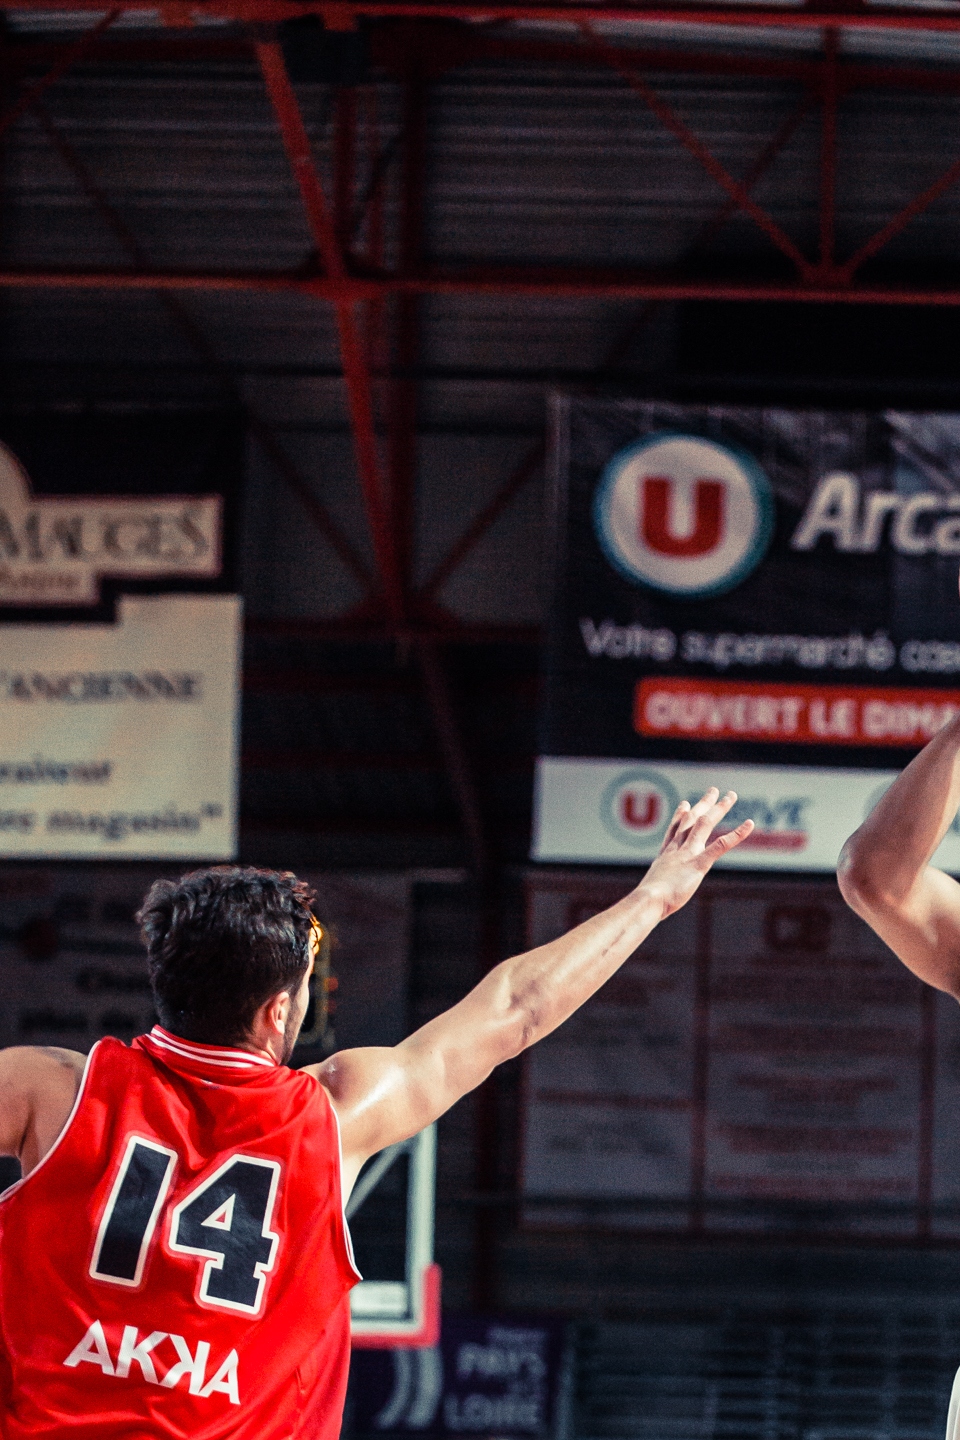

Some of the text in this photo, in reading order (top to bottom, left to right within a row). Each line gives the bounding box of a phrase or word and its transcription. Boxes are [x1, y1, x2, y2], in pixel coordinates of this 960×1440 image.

[642, 476, 725, 560] U
[579, 616, 678, 662] Votre
[682, 629, 896, 672] supermarché
[645, 691, 798, 734] OUVERT
[808, 697, 860, 737] LE
[620, 790, 663, 831] U
[89, 1134, 281, 1317] 14
[63, 1319, 241, 1405] AKKA
